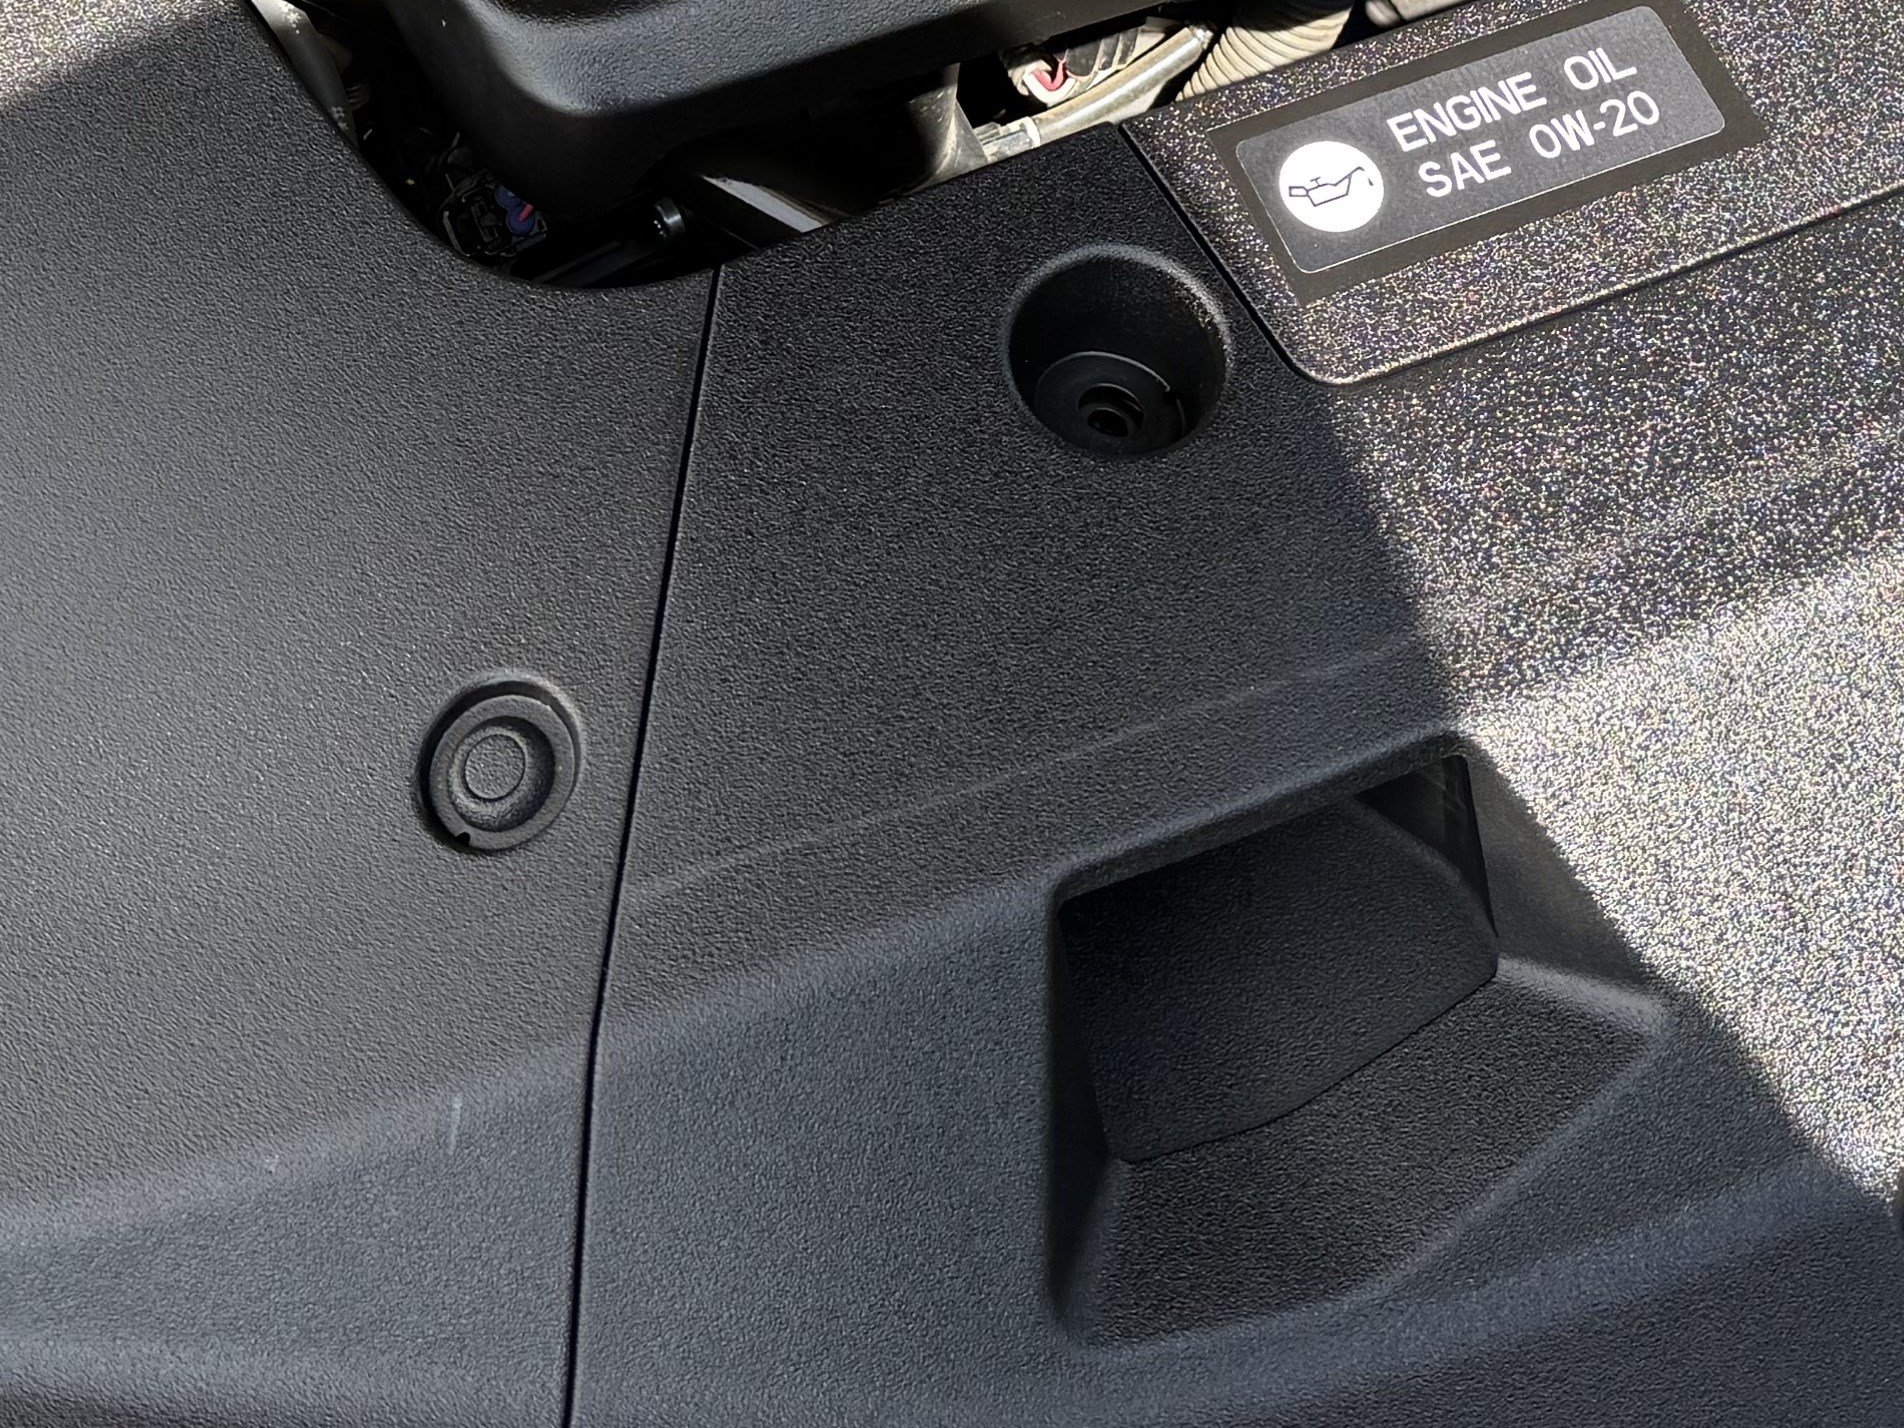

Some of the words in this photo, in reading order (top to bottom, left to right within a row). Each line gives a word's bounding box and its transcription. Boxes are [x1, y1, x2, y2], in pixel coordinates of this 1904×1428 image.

[1387, 71, 1547, 152] ENGINE
[1563, 47, 1638, 92] OIL
[1419, 141, 1512, 198] SAE
